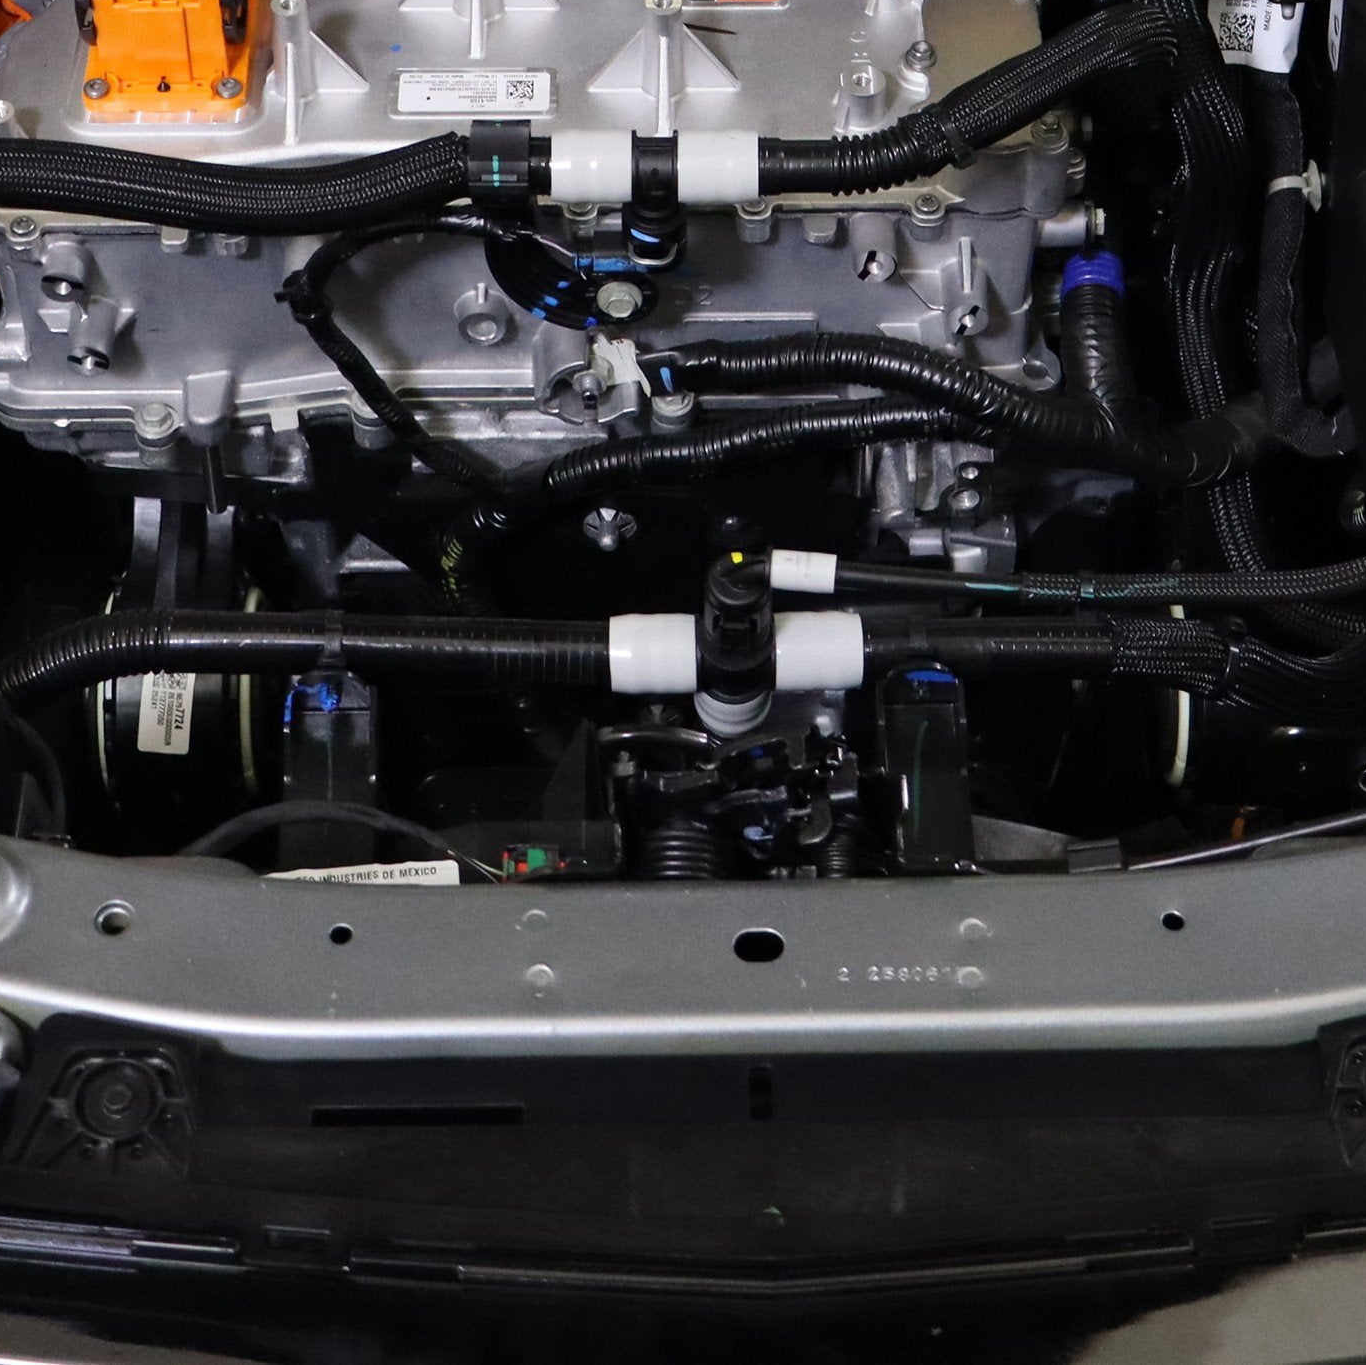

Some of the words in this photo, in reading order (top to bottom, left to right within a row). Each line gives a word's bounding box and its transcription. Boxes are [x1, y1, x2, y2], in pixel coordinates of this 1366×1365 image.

[1263, 10, 1272, 32] MADE
[382, 871, 394, 880] DE
[399, 867, 437, 878] MEXICO
